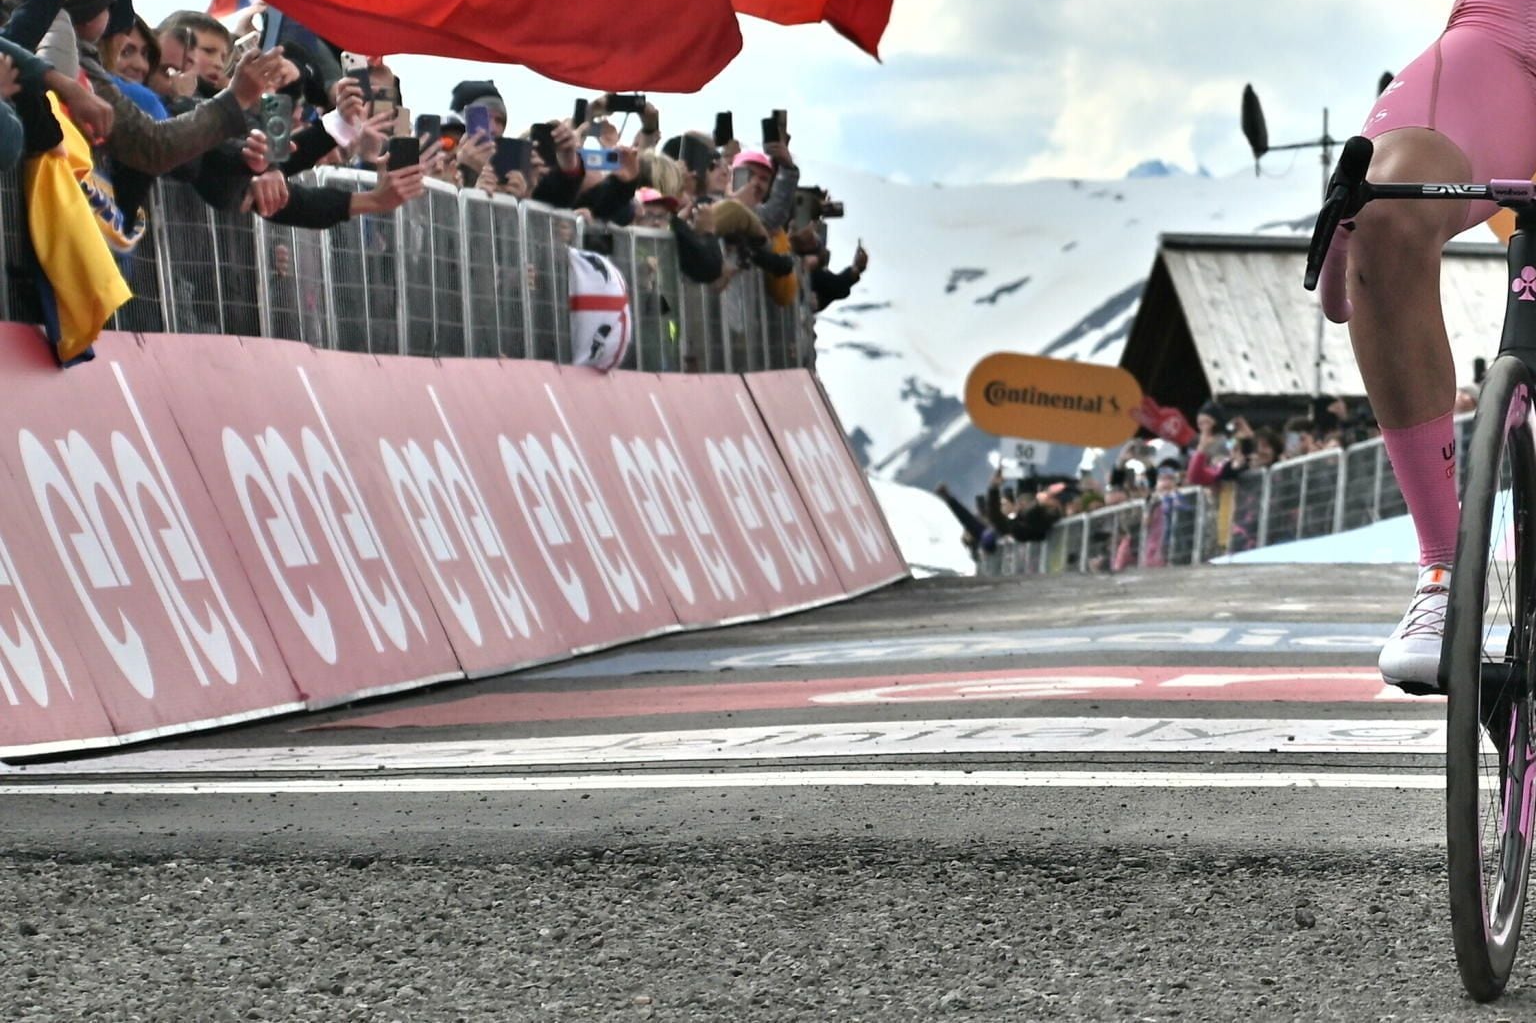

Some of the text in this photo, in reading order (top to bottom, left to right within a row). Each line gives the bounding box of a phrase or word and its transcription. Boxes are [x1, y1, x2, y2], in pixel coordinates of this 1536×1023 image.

[498, 383, 654, 624] enel
[611, 393, 747, 605] enel
[705, 393, 825, 593] enel
[785, 386, 887, 573] enel
[984, 380, 1103, 414] Continental
[19, 361, 262, 700] enel
[222, 366, 428, 665] enel
[379, 384, 546, 648] enel
